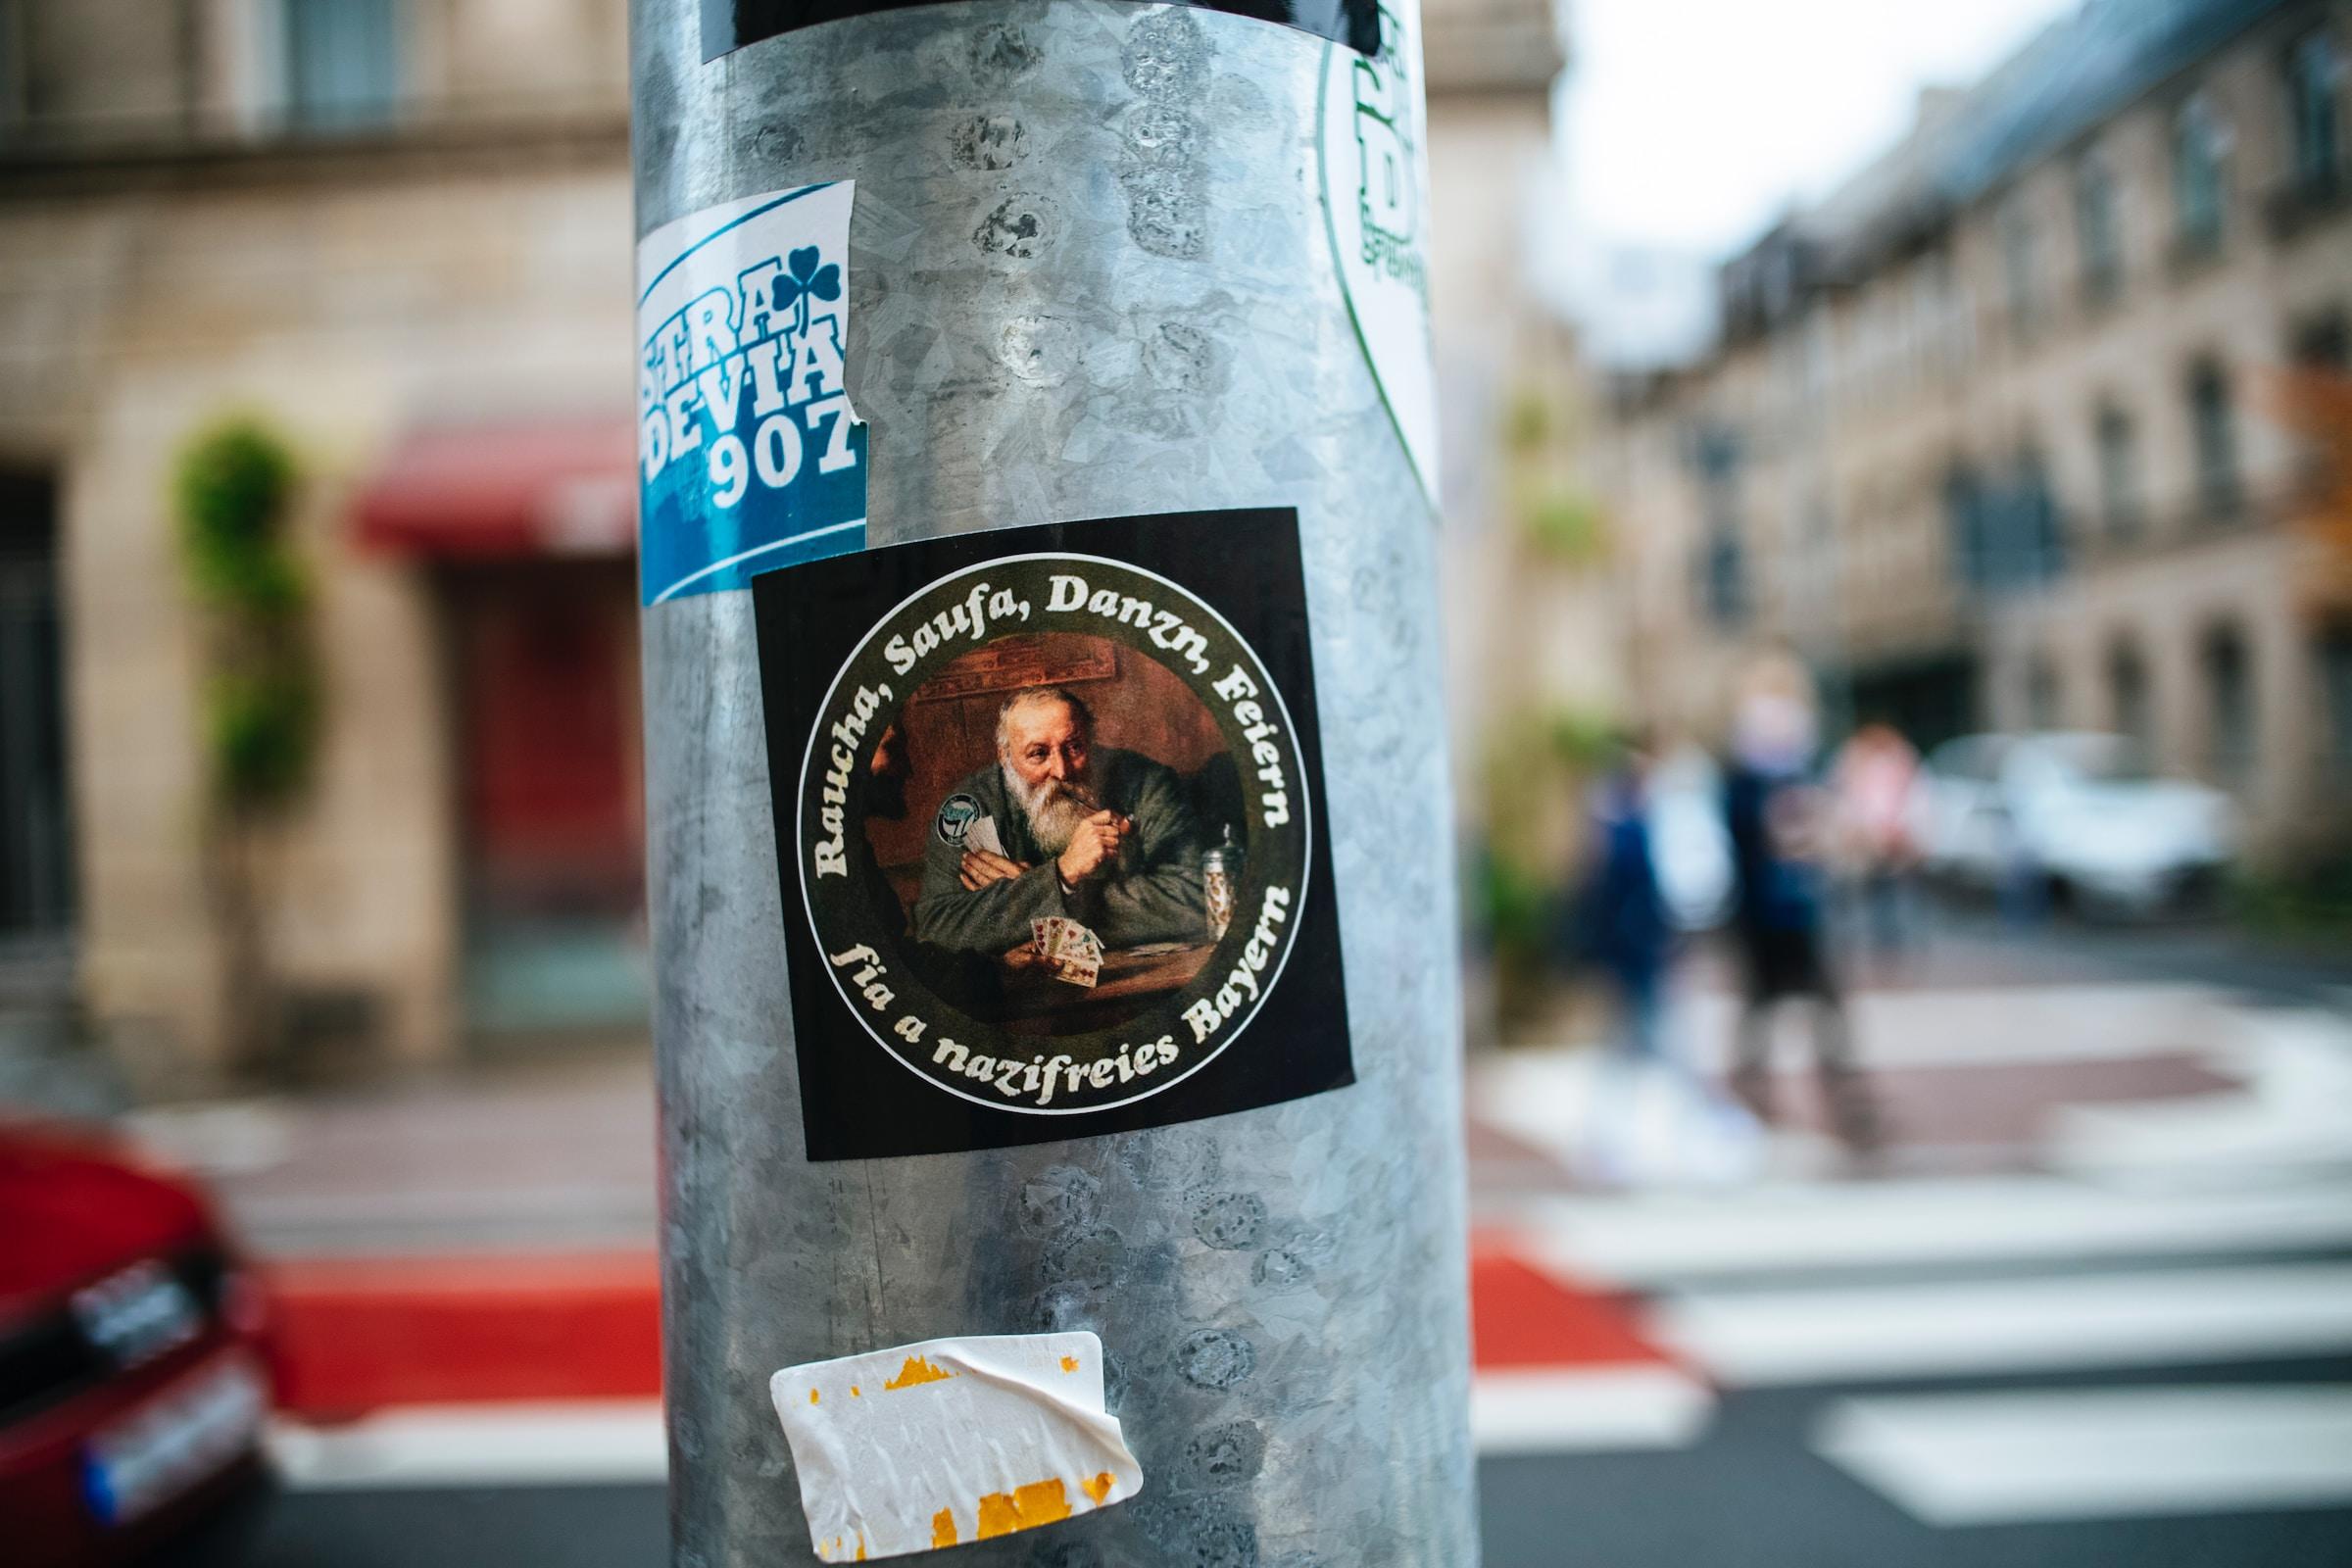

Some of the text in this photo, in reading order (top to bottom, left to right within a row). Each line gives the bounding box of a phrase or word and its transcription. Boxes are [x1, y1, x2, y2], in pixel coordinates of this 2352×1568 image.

[710, 393, 857, 509] 907
[815, 575, 1290, 879] Raucha, Saufa, Danzn, Feiern
[830, 886, 1290, 1104] fia a nazifreies Bayern
